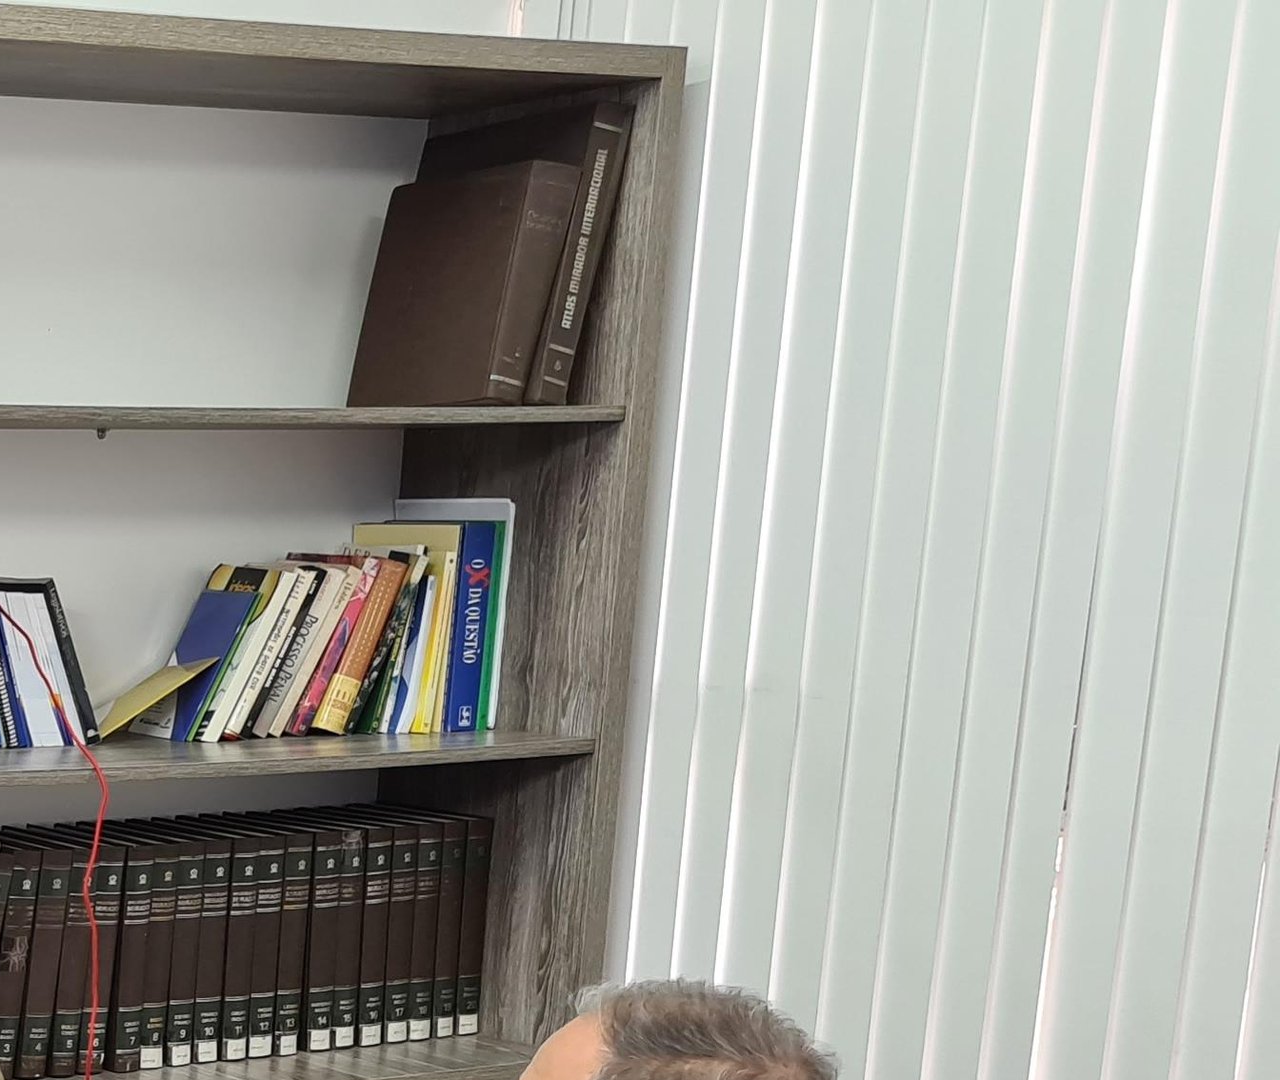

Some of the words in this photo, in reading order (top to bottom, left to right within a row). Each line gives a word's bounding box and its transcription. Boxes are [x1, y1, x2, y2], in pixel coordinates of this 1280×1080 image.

[561, 292, 577, 329] ATLAS
[569, 237, 589, 295] MIRADOR
[581, 148, 608, 235] INTERNACIONAL
[471, 558, 485, 569] O
[465, 565, 490, 588] X
[468, 588, 483, 604] DA
[462, 608, 481, 664] QUESTÃO
[286, 615, 319, 669] PROCESSO
[268, 666, 293, 703] PENAL
[395, 1008, 404, 1017] 17
[286, 1018, 295, 1028] 13
[317, 1016, 327, 1026] 14
[204, 1026, 214, 1036] 10
[259, 1022, 269, 1031] 12
[152, 1032, 159, 1042] 8
[180, 1029, 187, 1038] 9
[66, 1040, 73, 1048] 5
[93, 1038, 100, 1047] 6
[130, 1037, 136, 1045] 7
[3, 1044, 11, 1053] 3
